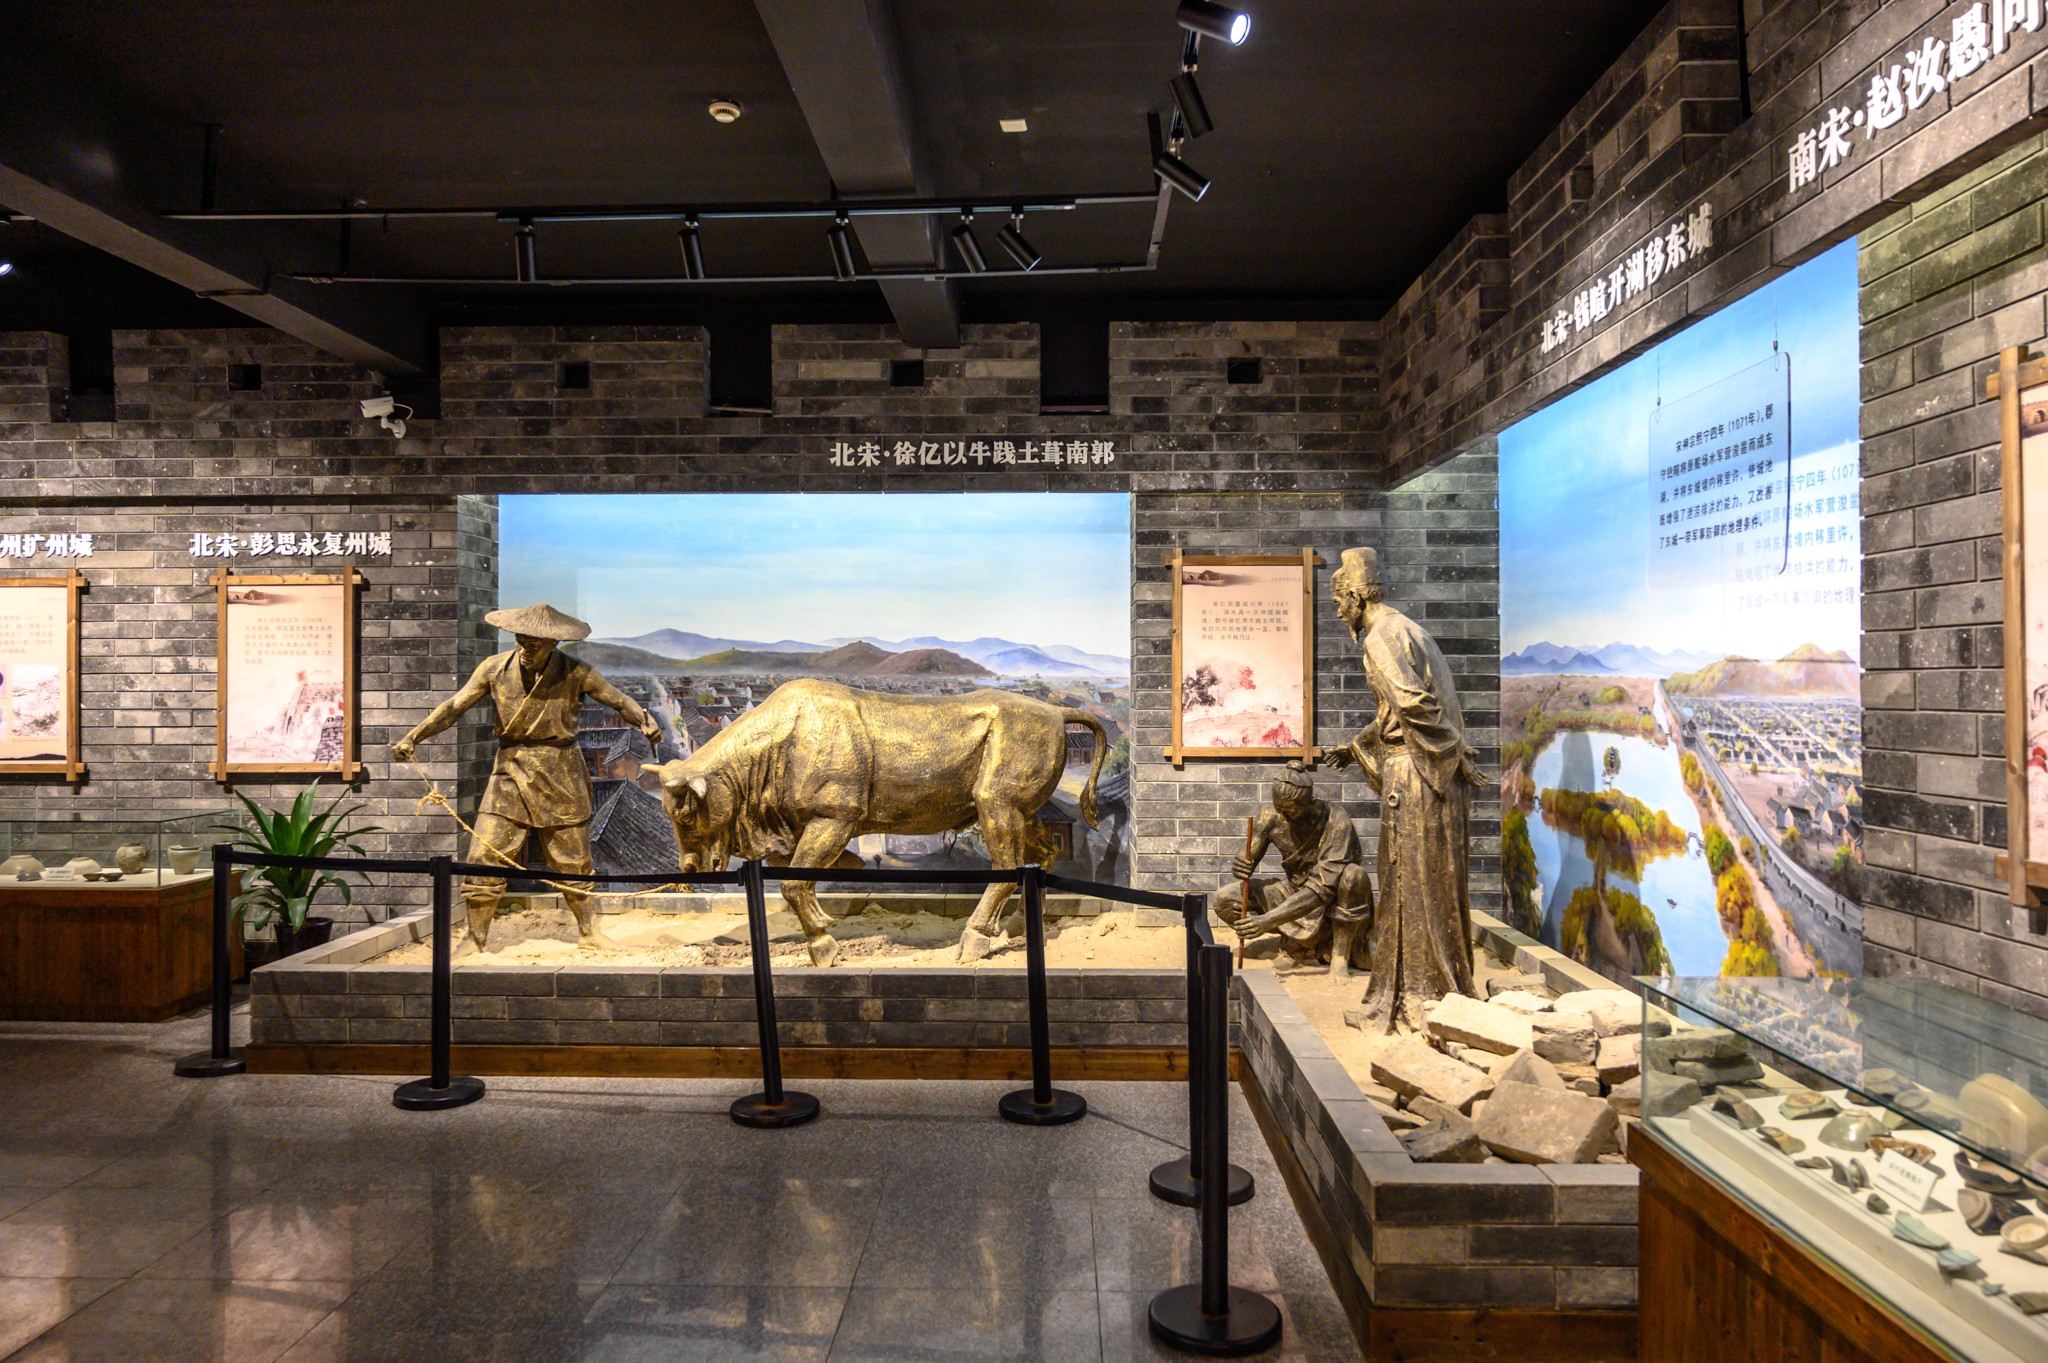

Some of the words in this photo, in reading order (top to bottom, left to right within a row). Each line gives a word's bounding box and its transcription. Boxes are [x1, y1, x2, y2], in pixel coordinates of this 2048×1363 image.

[829, 440, 1115, 467] 北宋·徐亿以牛践土葺南郭
[0, 533, 93, 557] 州扩州城
[189, 532, 392, 557] 北宋·彭思永复州城
